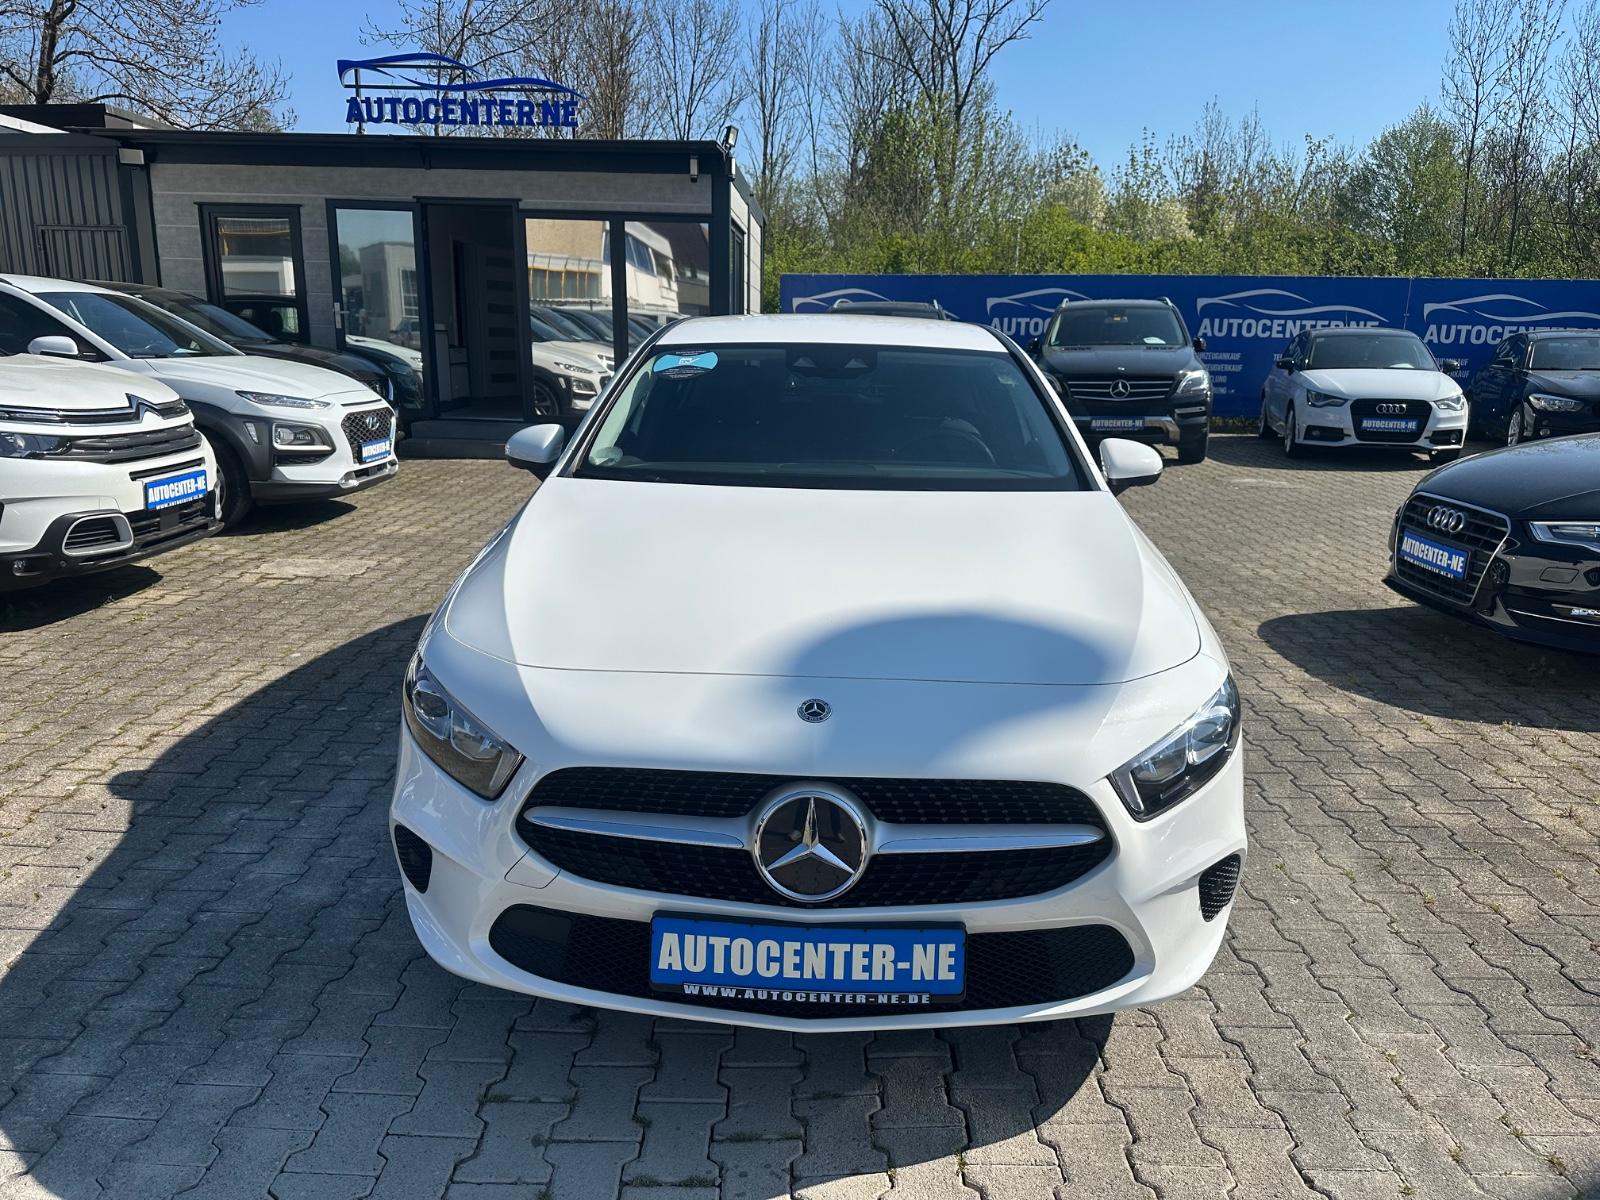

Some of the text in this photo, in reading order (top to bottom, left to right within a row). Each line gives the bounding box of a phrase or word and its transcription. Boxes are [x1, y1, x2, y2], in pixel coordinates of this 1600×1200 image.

[148, 475, 206, 503] AUTOCENTER-NE
[1401, 537, 1465, 573] AUTOCENTER-NE
[658, 932, 956, 981] AUTOCENTER-NE
[683, 984, 930, 1004] WWW.AUTOCENTER-NE.DE
